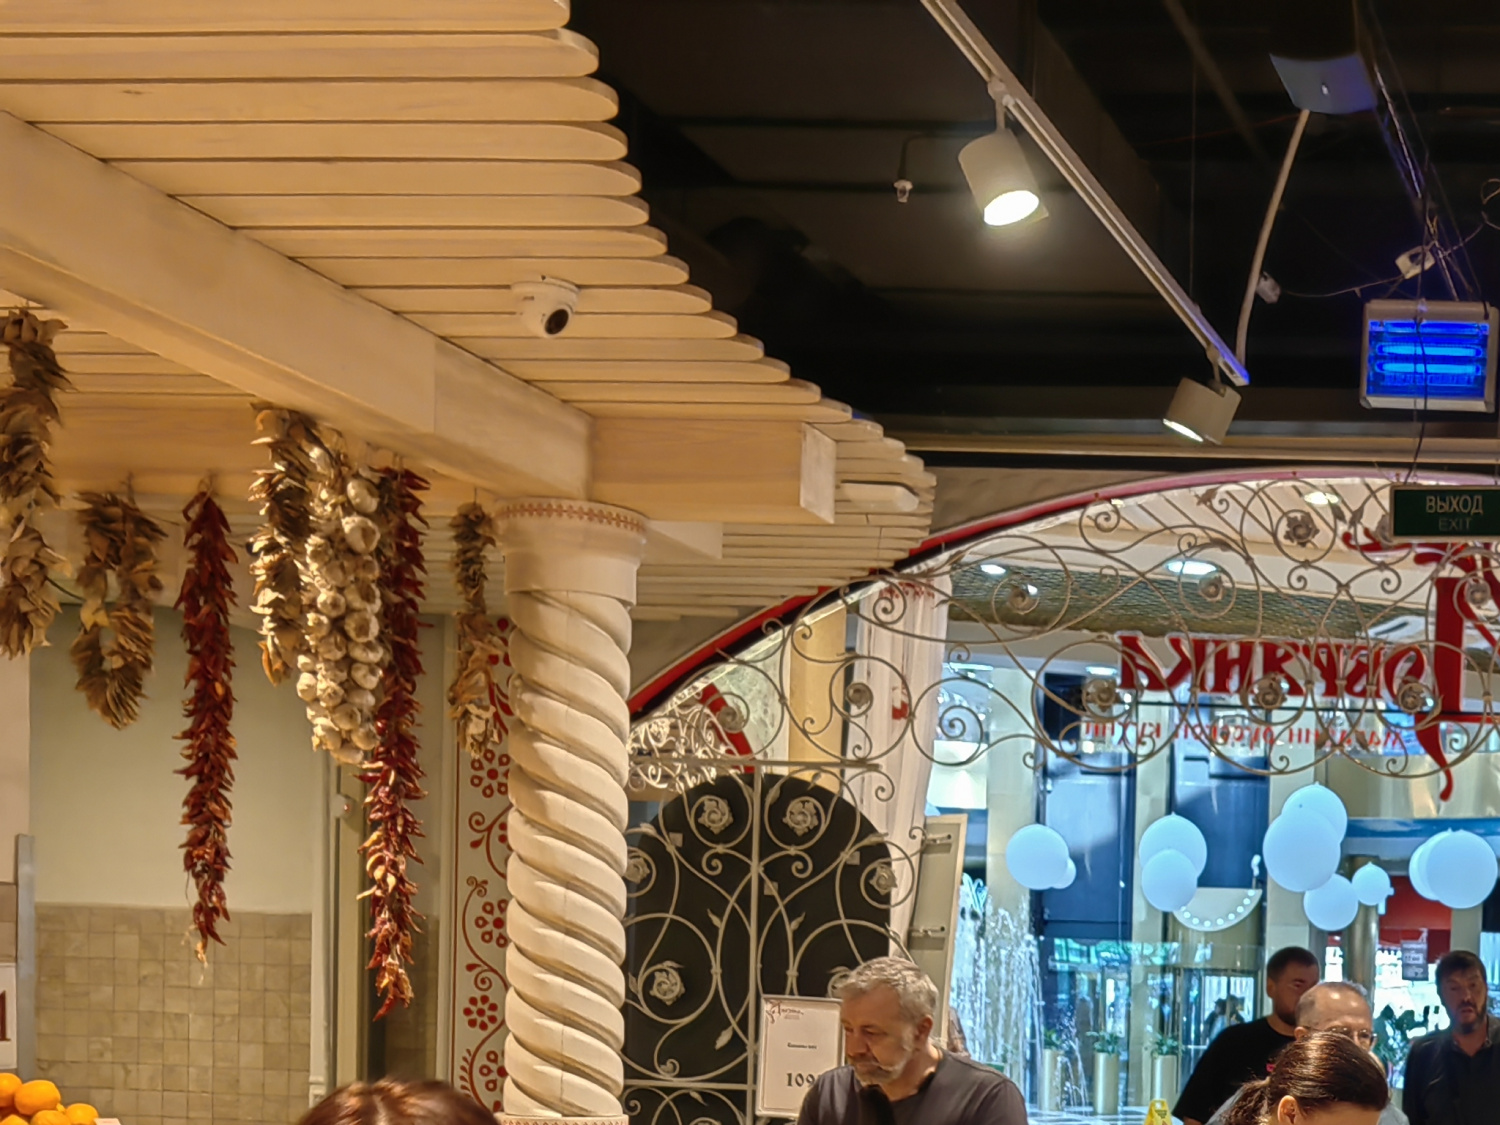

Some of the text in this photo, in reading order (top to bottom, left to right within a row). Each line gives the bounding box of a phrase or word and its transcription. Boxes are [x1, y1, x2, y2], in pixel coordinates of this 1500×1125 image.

[1425, 494, 1484, 516] ВЫХОД
[1438, 517, 1473, 531] EXIT
[786, 1072, 815, 1088] 109
